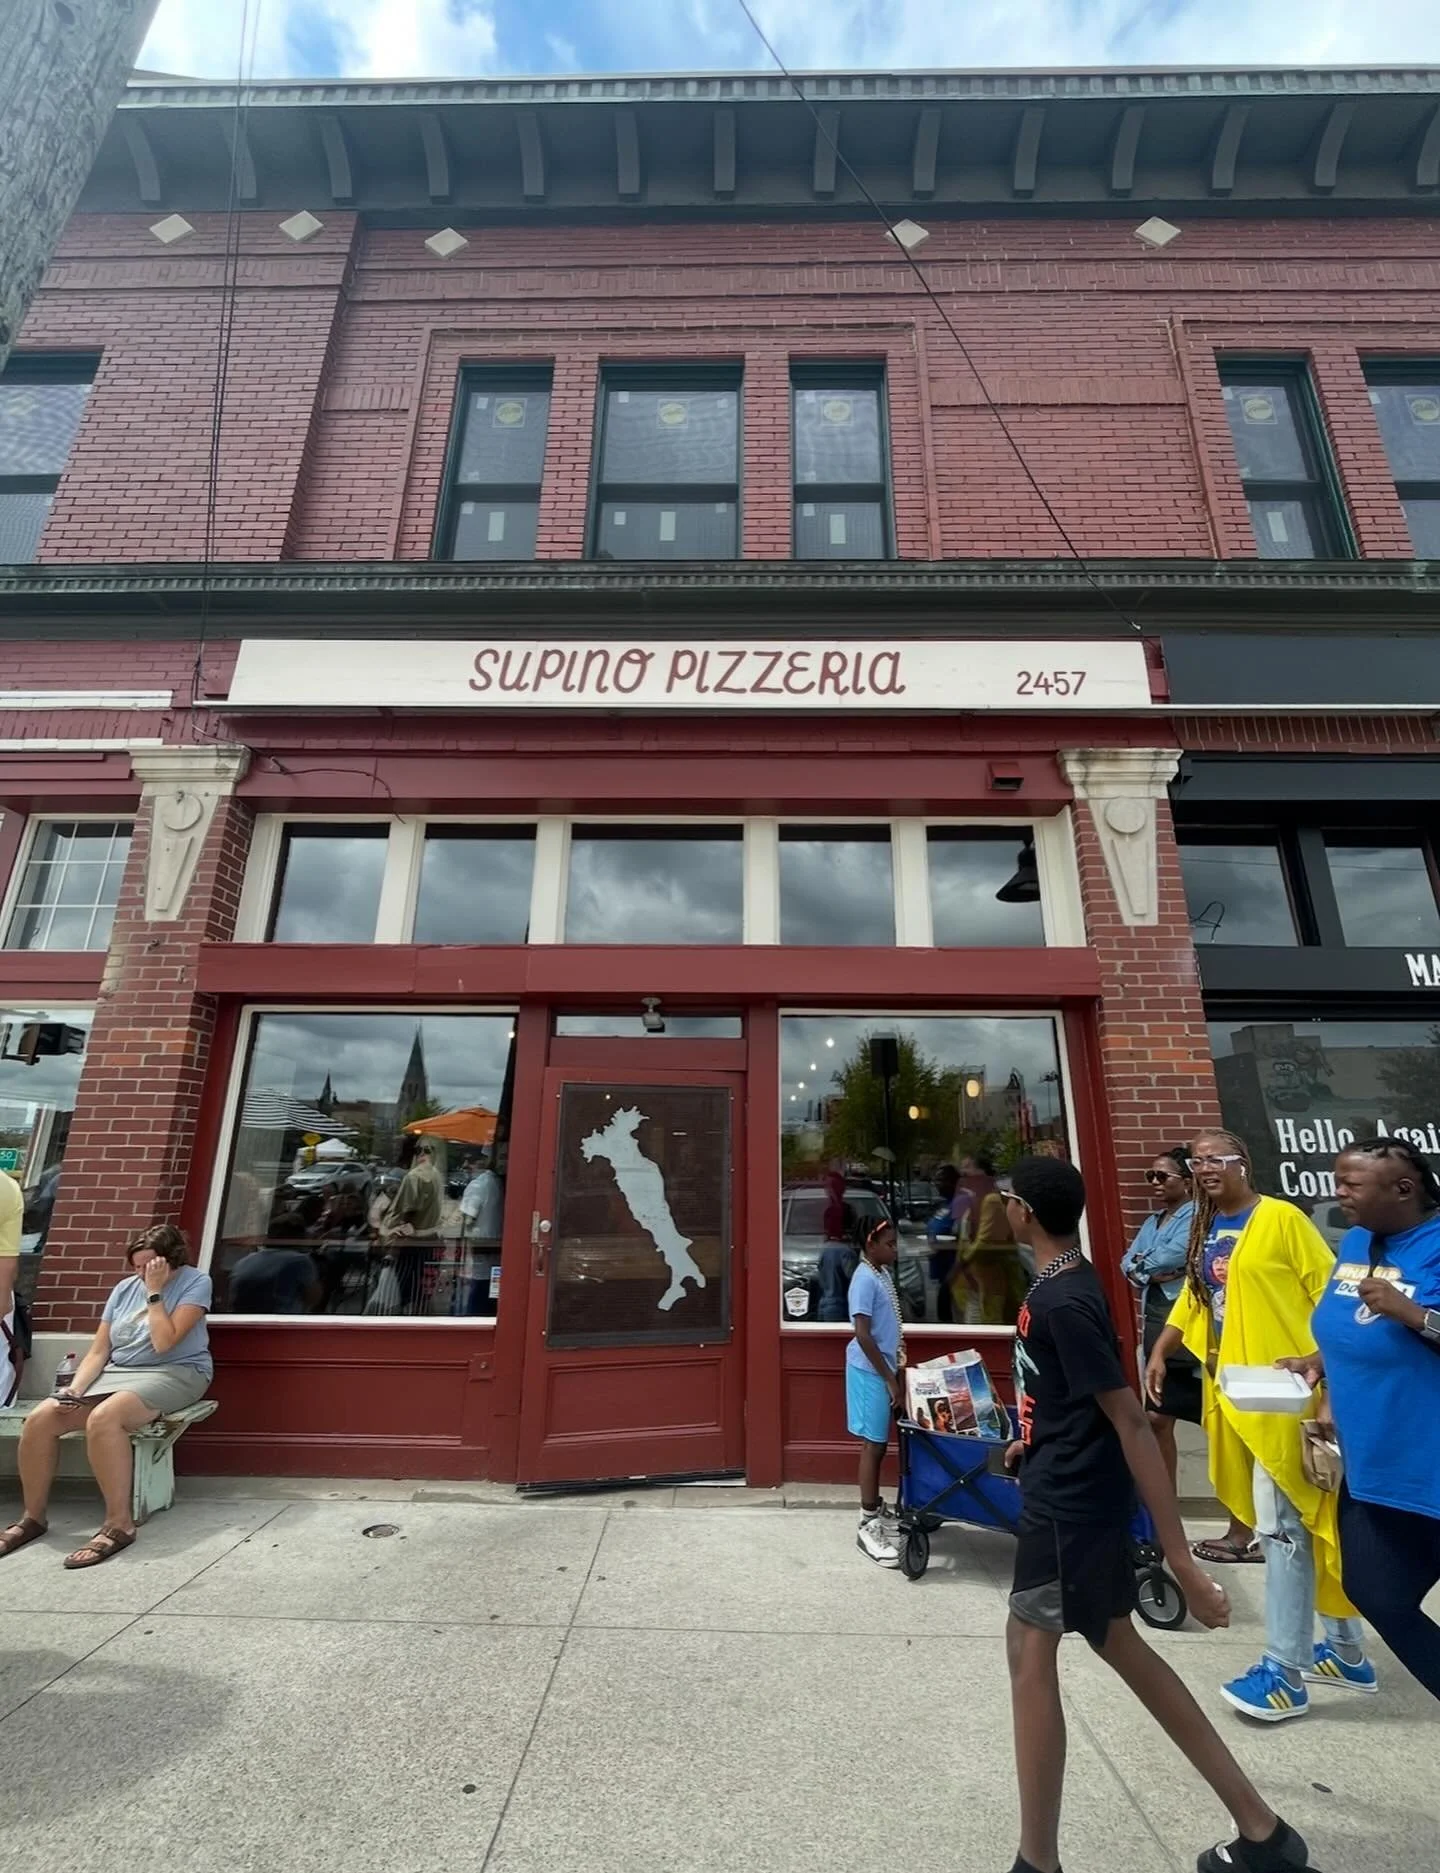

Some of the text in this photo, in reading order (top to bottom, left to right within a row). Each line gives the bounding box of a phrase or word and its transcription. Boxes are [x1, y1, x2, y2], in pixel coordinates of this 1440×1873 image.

[468, 648, 906, 695] SUPINO PIZZERIA
[1016, 670, 1087, 696] 2457
[1404, 953, 1440, 986] MA
[1274, 1118, 1440, 1155] Hello Agai
[1279, 1160, 1337, 1198] Com
